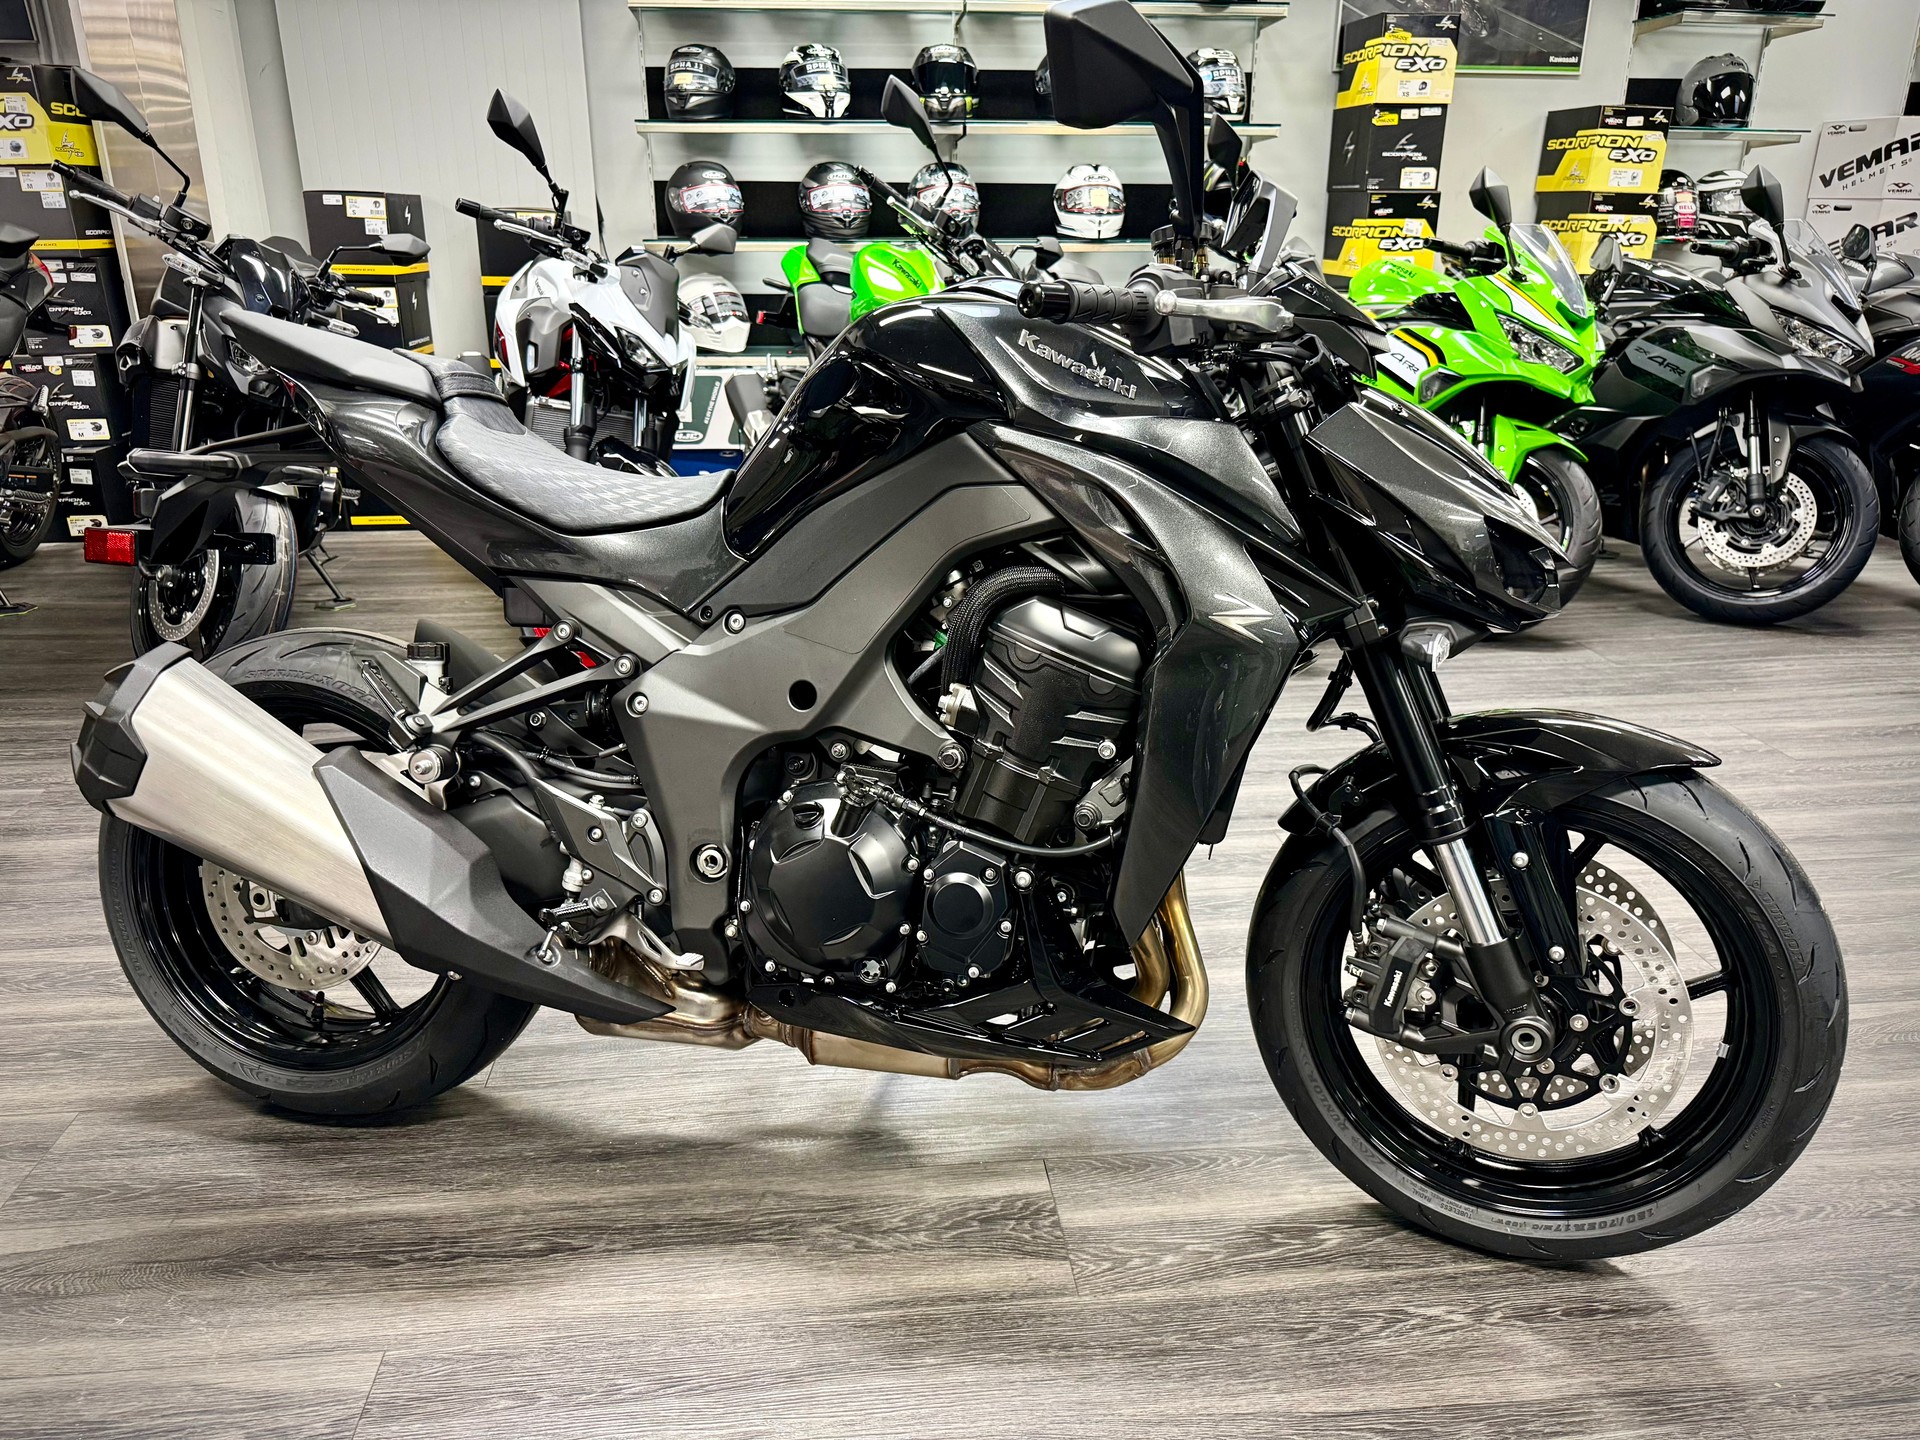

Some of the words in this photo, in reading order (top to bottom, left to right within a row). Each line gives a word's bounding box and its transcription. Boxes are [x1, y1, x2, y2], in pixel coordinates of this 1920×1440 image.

[1343, 43, 1429, 65] SCORPION
[1546, 135, 1641, 150] SCORPION
[892, 258, 922, 289] Kawasaki
[1018, 328, 1138, 400] Kawasaki
[1761, 890, 1807, 970] DUNLOP
[1383, 969, 1403, 1007] Kawasaki
[1412, 1188, 1433, 1203] RADIAL
[1440, 1203, 1472, 1219] TUBELESS
